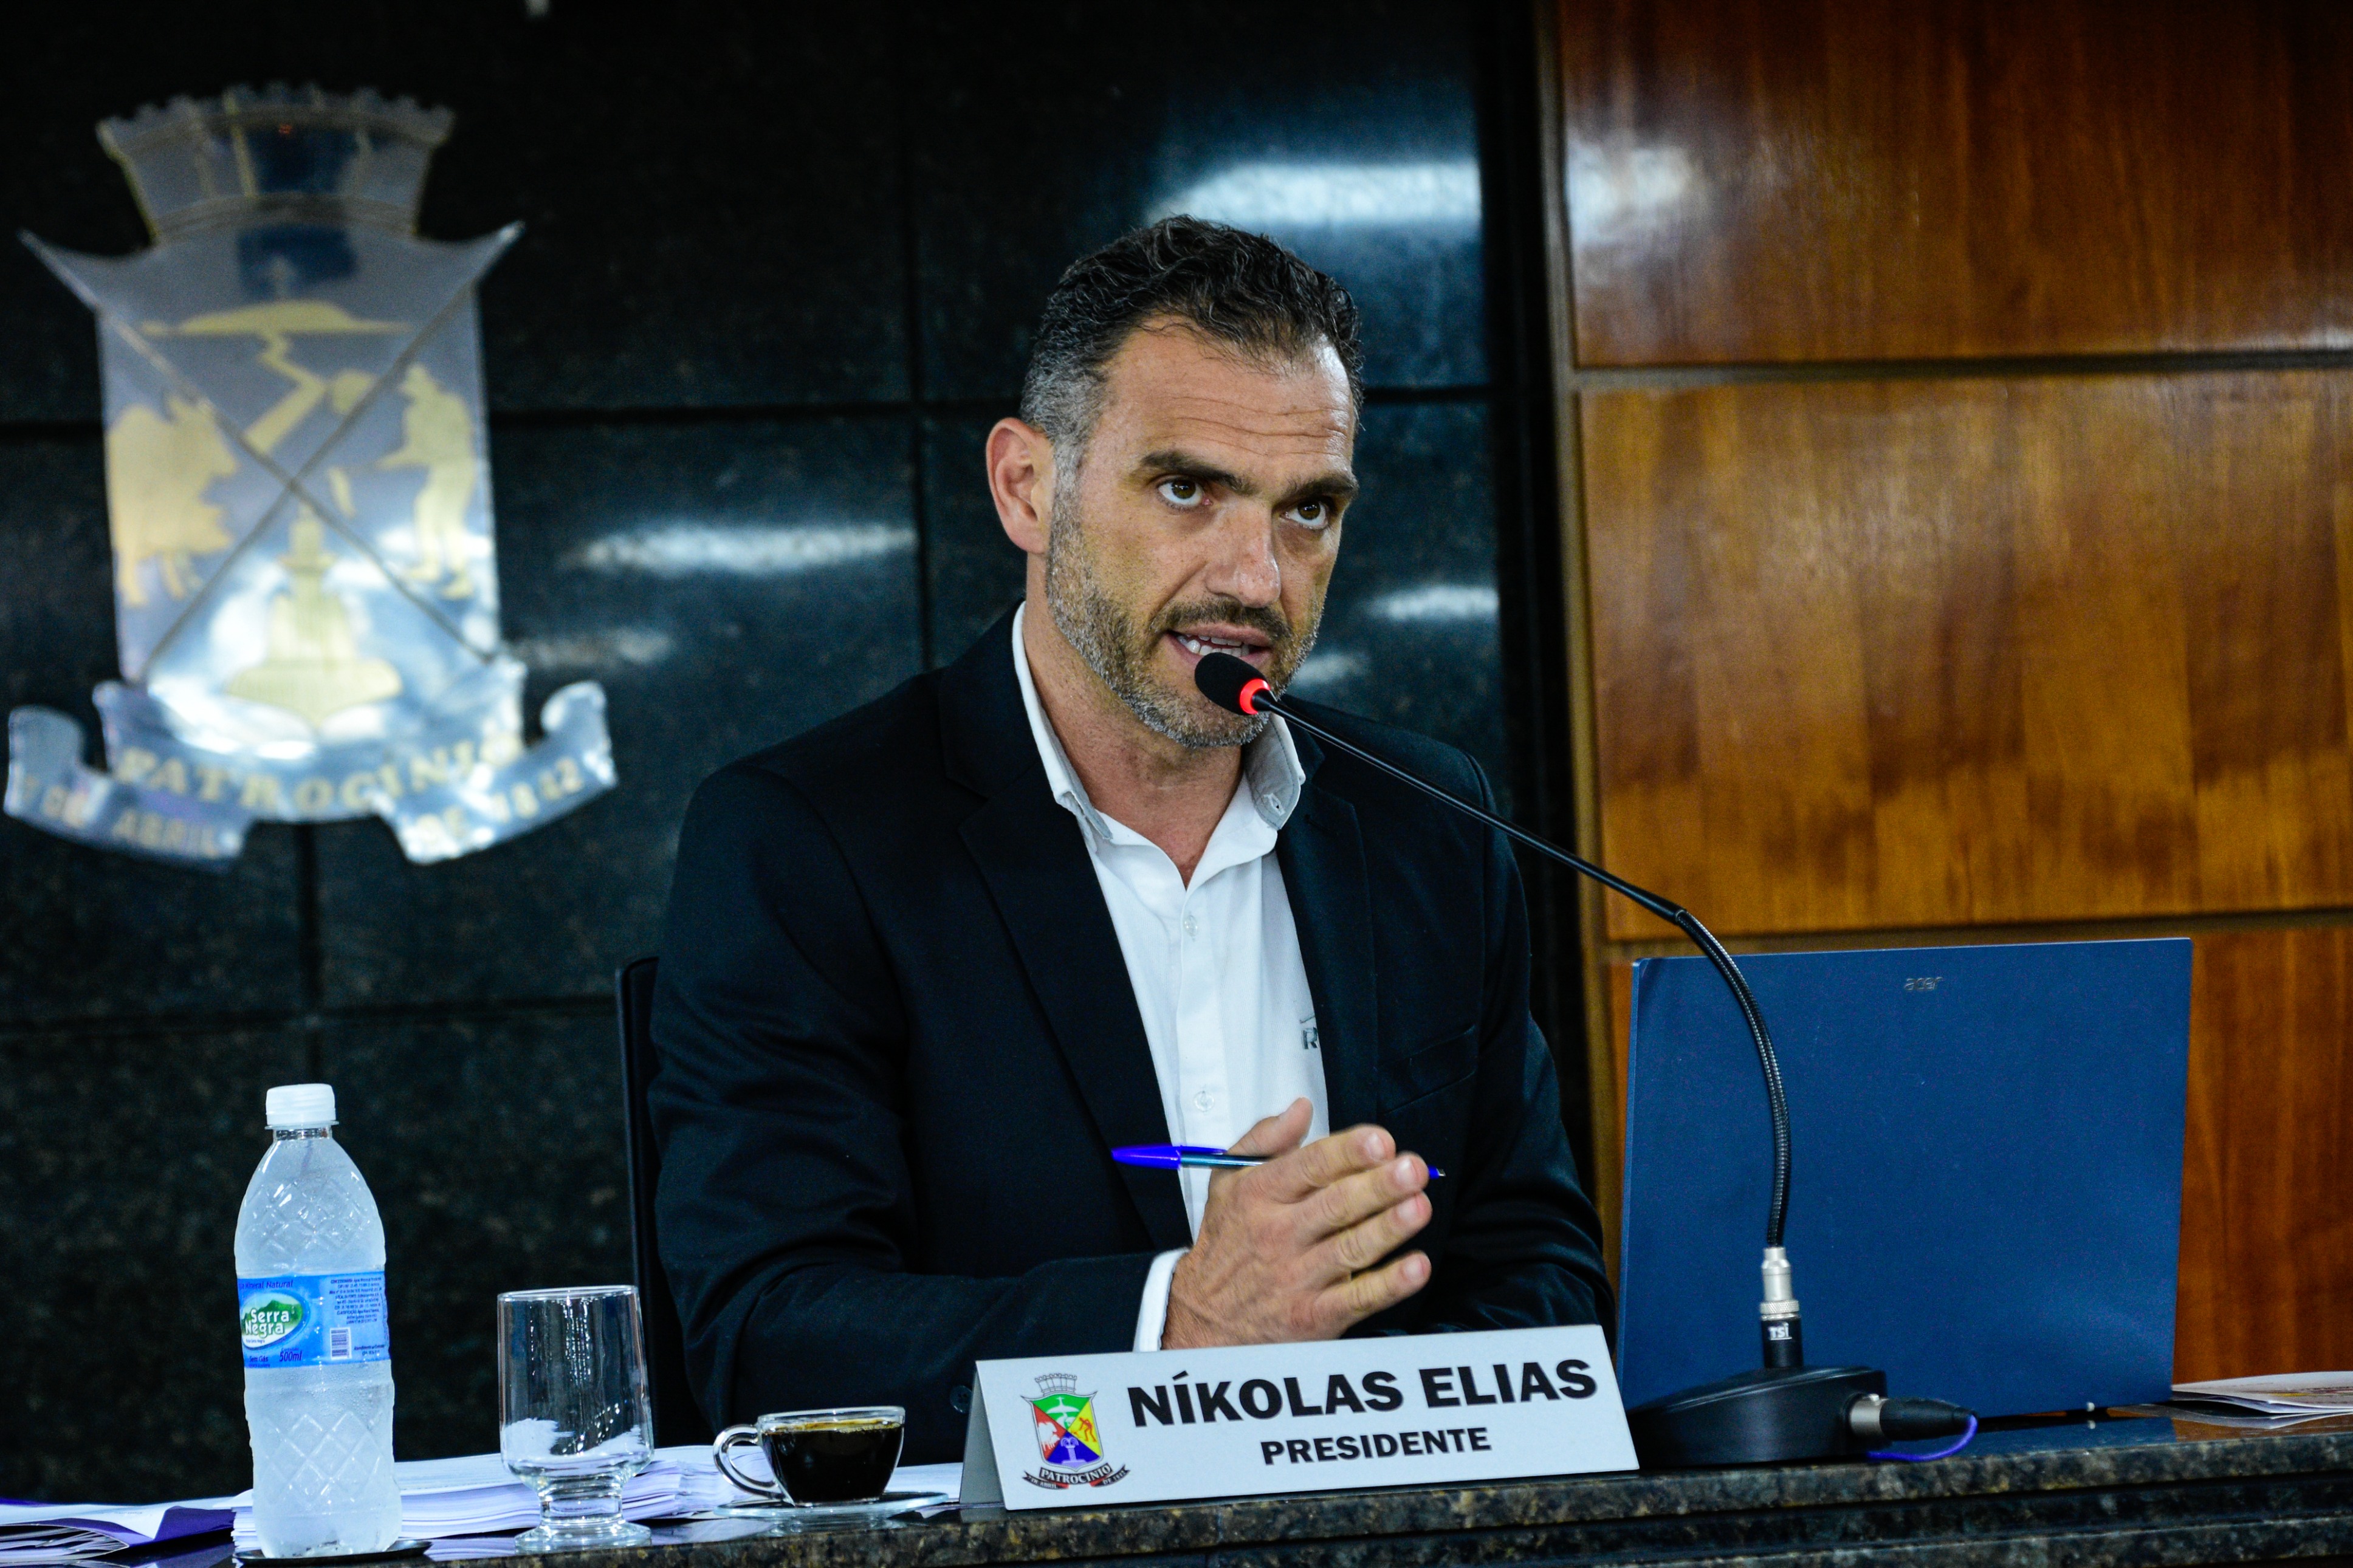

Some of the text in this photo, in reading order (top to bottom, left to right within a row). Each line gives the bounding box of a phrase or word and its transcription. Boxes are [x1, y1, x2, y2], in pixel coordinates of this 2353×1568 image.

[1904, 977, 1943, 991] acer
[266, 1279, 294, 1289] Natural
[250, 1308, 290, 1323] Serra
[245, 1320, 284, 1338] Negra
[280, 1350, 303, 1361] 500ml
[1128, 1360, 1596, 1426] NÍKOLAS ELIAS
[1261, 1428, 1490, 1465] PRESIDENTE
[1040, 1465, 1111, 1484] PATROCINIO
